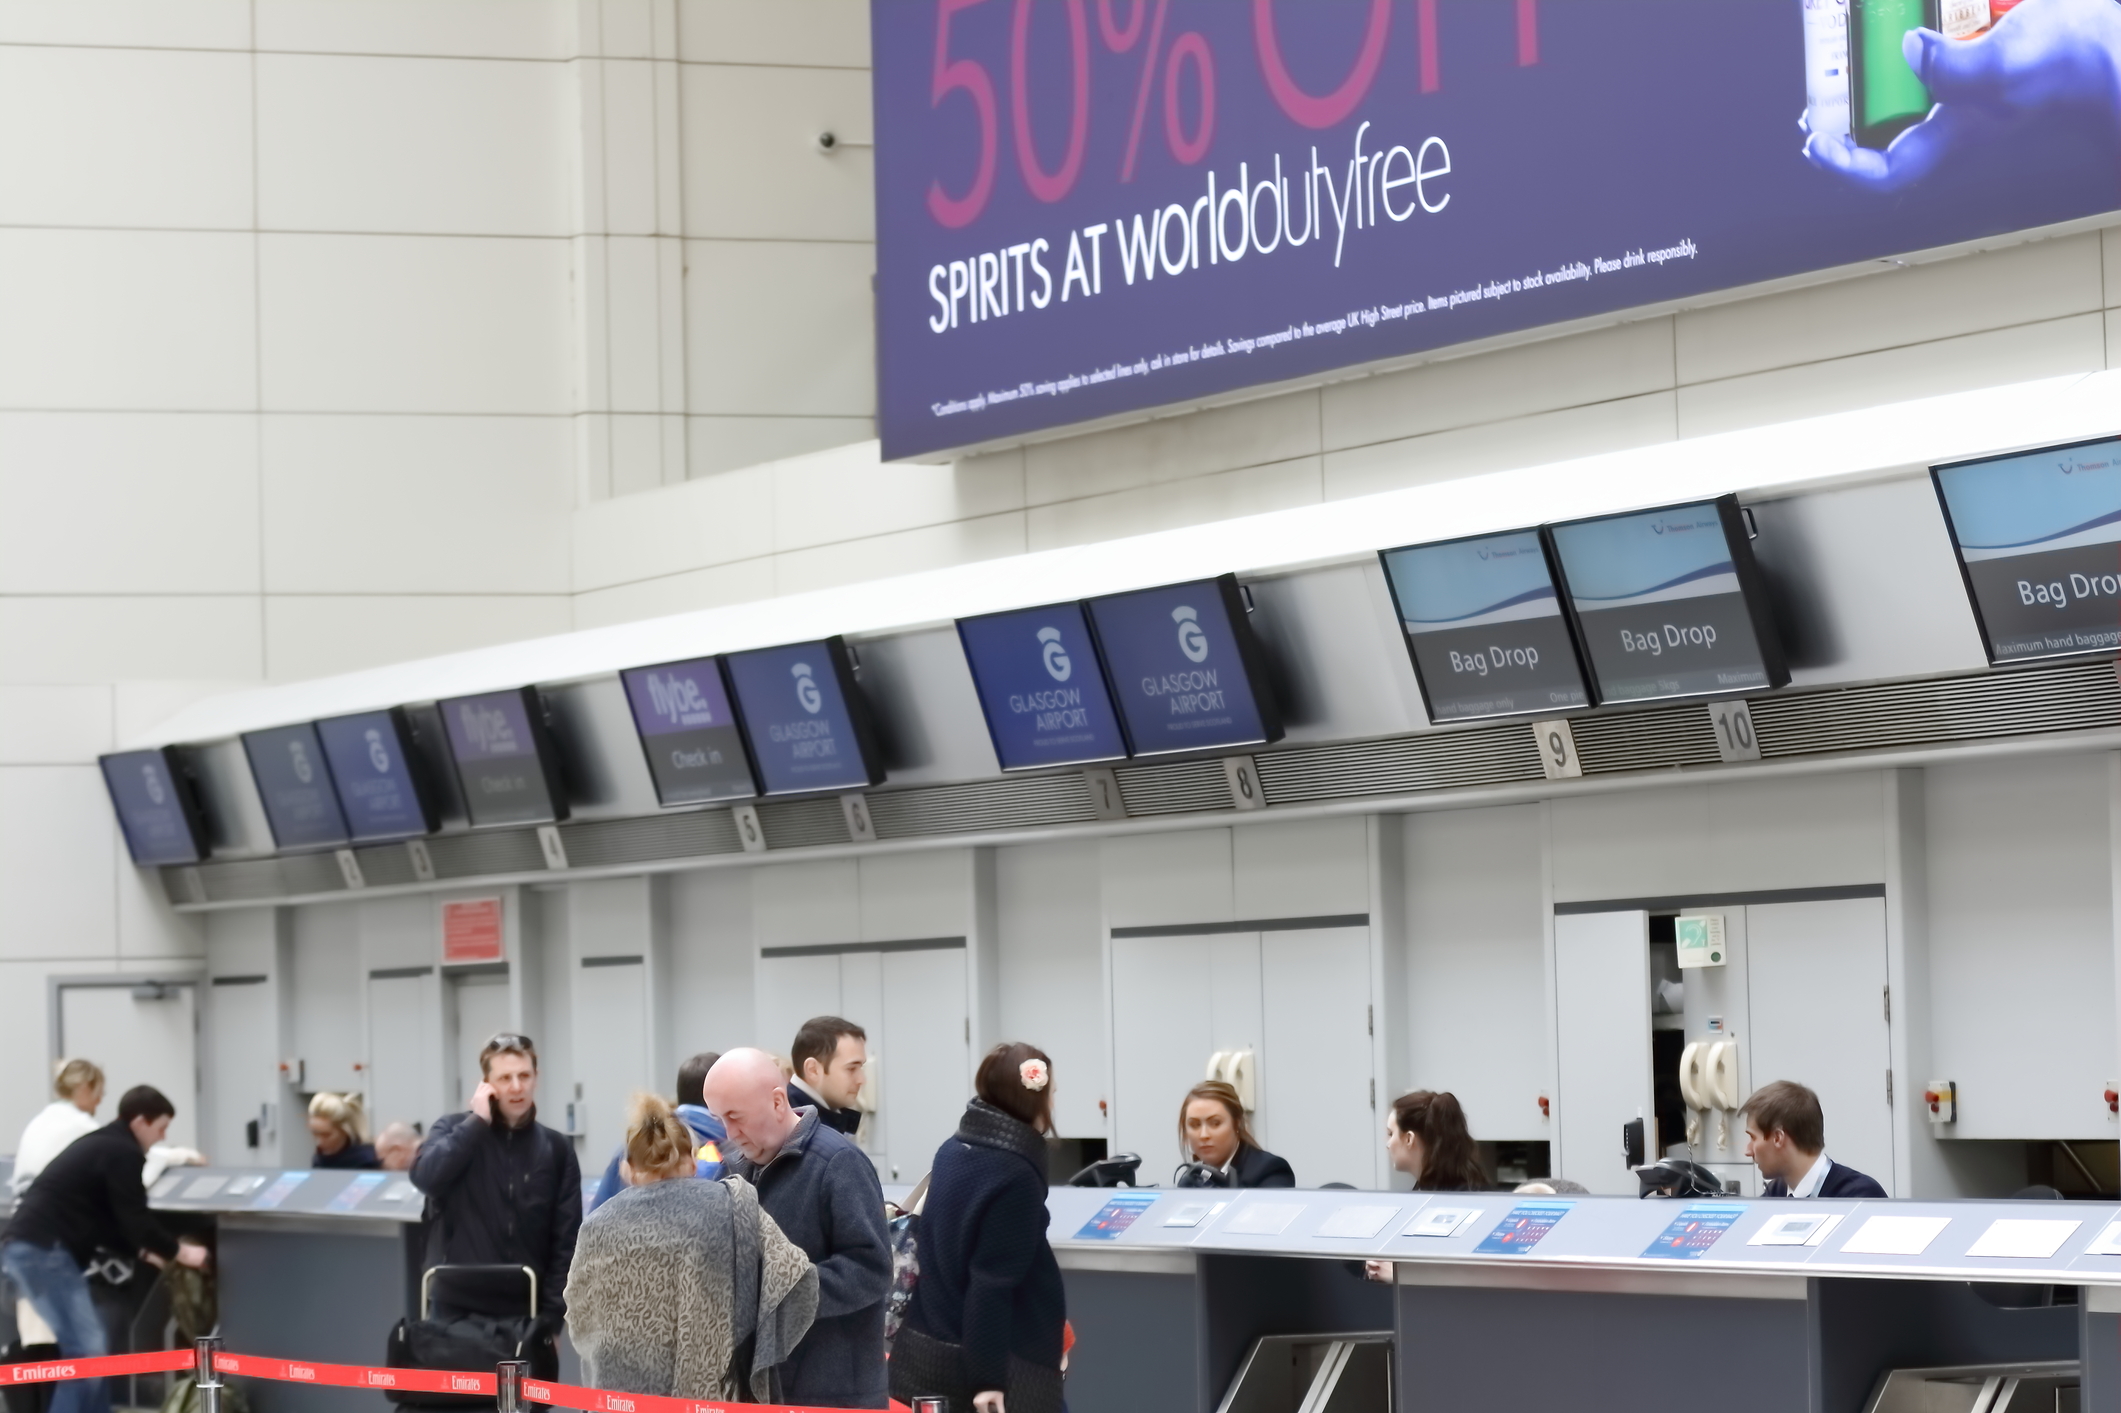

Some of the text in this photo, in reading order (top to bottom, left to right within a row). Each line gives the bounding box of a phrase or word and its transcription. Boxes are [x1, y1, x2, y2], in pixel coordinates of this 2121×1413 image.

[928, 237, 1053, 334] SPIRITS
[1061, 222, 1108, 302] AT
[1227, 337, 1255, 354] Savings
[1256, 324, 1292, 349] compared
[1293, 326, 1302, 339] to
[1302, 321, 1315, 337] the
[1316, 318, 1346, 335] average
[1347, 311, 1360, 328] UK
[1360, 306, 1379, 328] High
[1380, 303, 1403, 321] Street
[1404, 299, 1426, 320] price.
[1427, 295, 1449, 310] Items
[1449, 283, 1482, 310] pictured
[1483, 280, 1511, 300] subject
[1512, 278, 1521, 292] to
[1522, 270, 1544, 290] stock
[1545, 260, 1592, 281] availability.
[1594, 256, 1622, 274] Please
[1623, 247, 1645, 268] drink
[1647, 237, 1698, 265] responsibly.
[2017, 580, 2067, 608] Bag
[1620, 624, 1717, 656] Bag Drop
[2044, 635, 2074, 649] hand
[1449, 646, 1539, 676] Bag Drop
[1141, 668, 1217, 697] GLASGOW
[1717, 671, 1764, 685] Maximum
[1009, 687, 1080, 714] GLASGOW
[1170, 690, 1226, 715] AIRPORT
[1458, 699, 1495, 715] baggage
[1496, 696, 1514, 710] only
[1549, 691, 1569, 703] One
[1036, 708, 1089, 732] AIRPORT
[1717, 711, 1753, 751] 10
[671, 746, 708, 770] Check
[1547, 731, 1568, 768] 9
[1095, 777, 1111, 810] 7
[1236, 766, 1253, 800] 8
[742, 813, 757, 843] 5
[12, 1364, 77, 1382] Emirates
[213, 1355, 239, 1371] Emirates
[289, 1363, 315, 1380] Emirates
[367, 1370, 396, 1386] Emirates
[451, 1375, 481, 1392] Emirates
[523, 1382, 551, 1401] Emirates
[606, 1394, 636, 1412] Emirates
